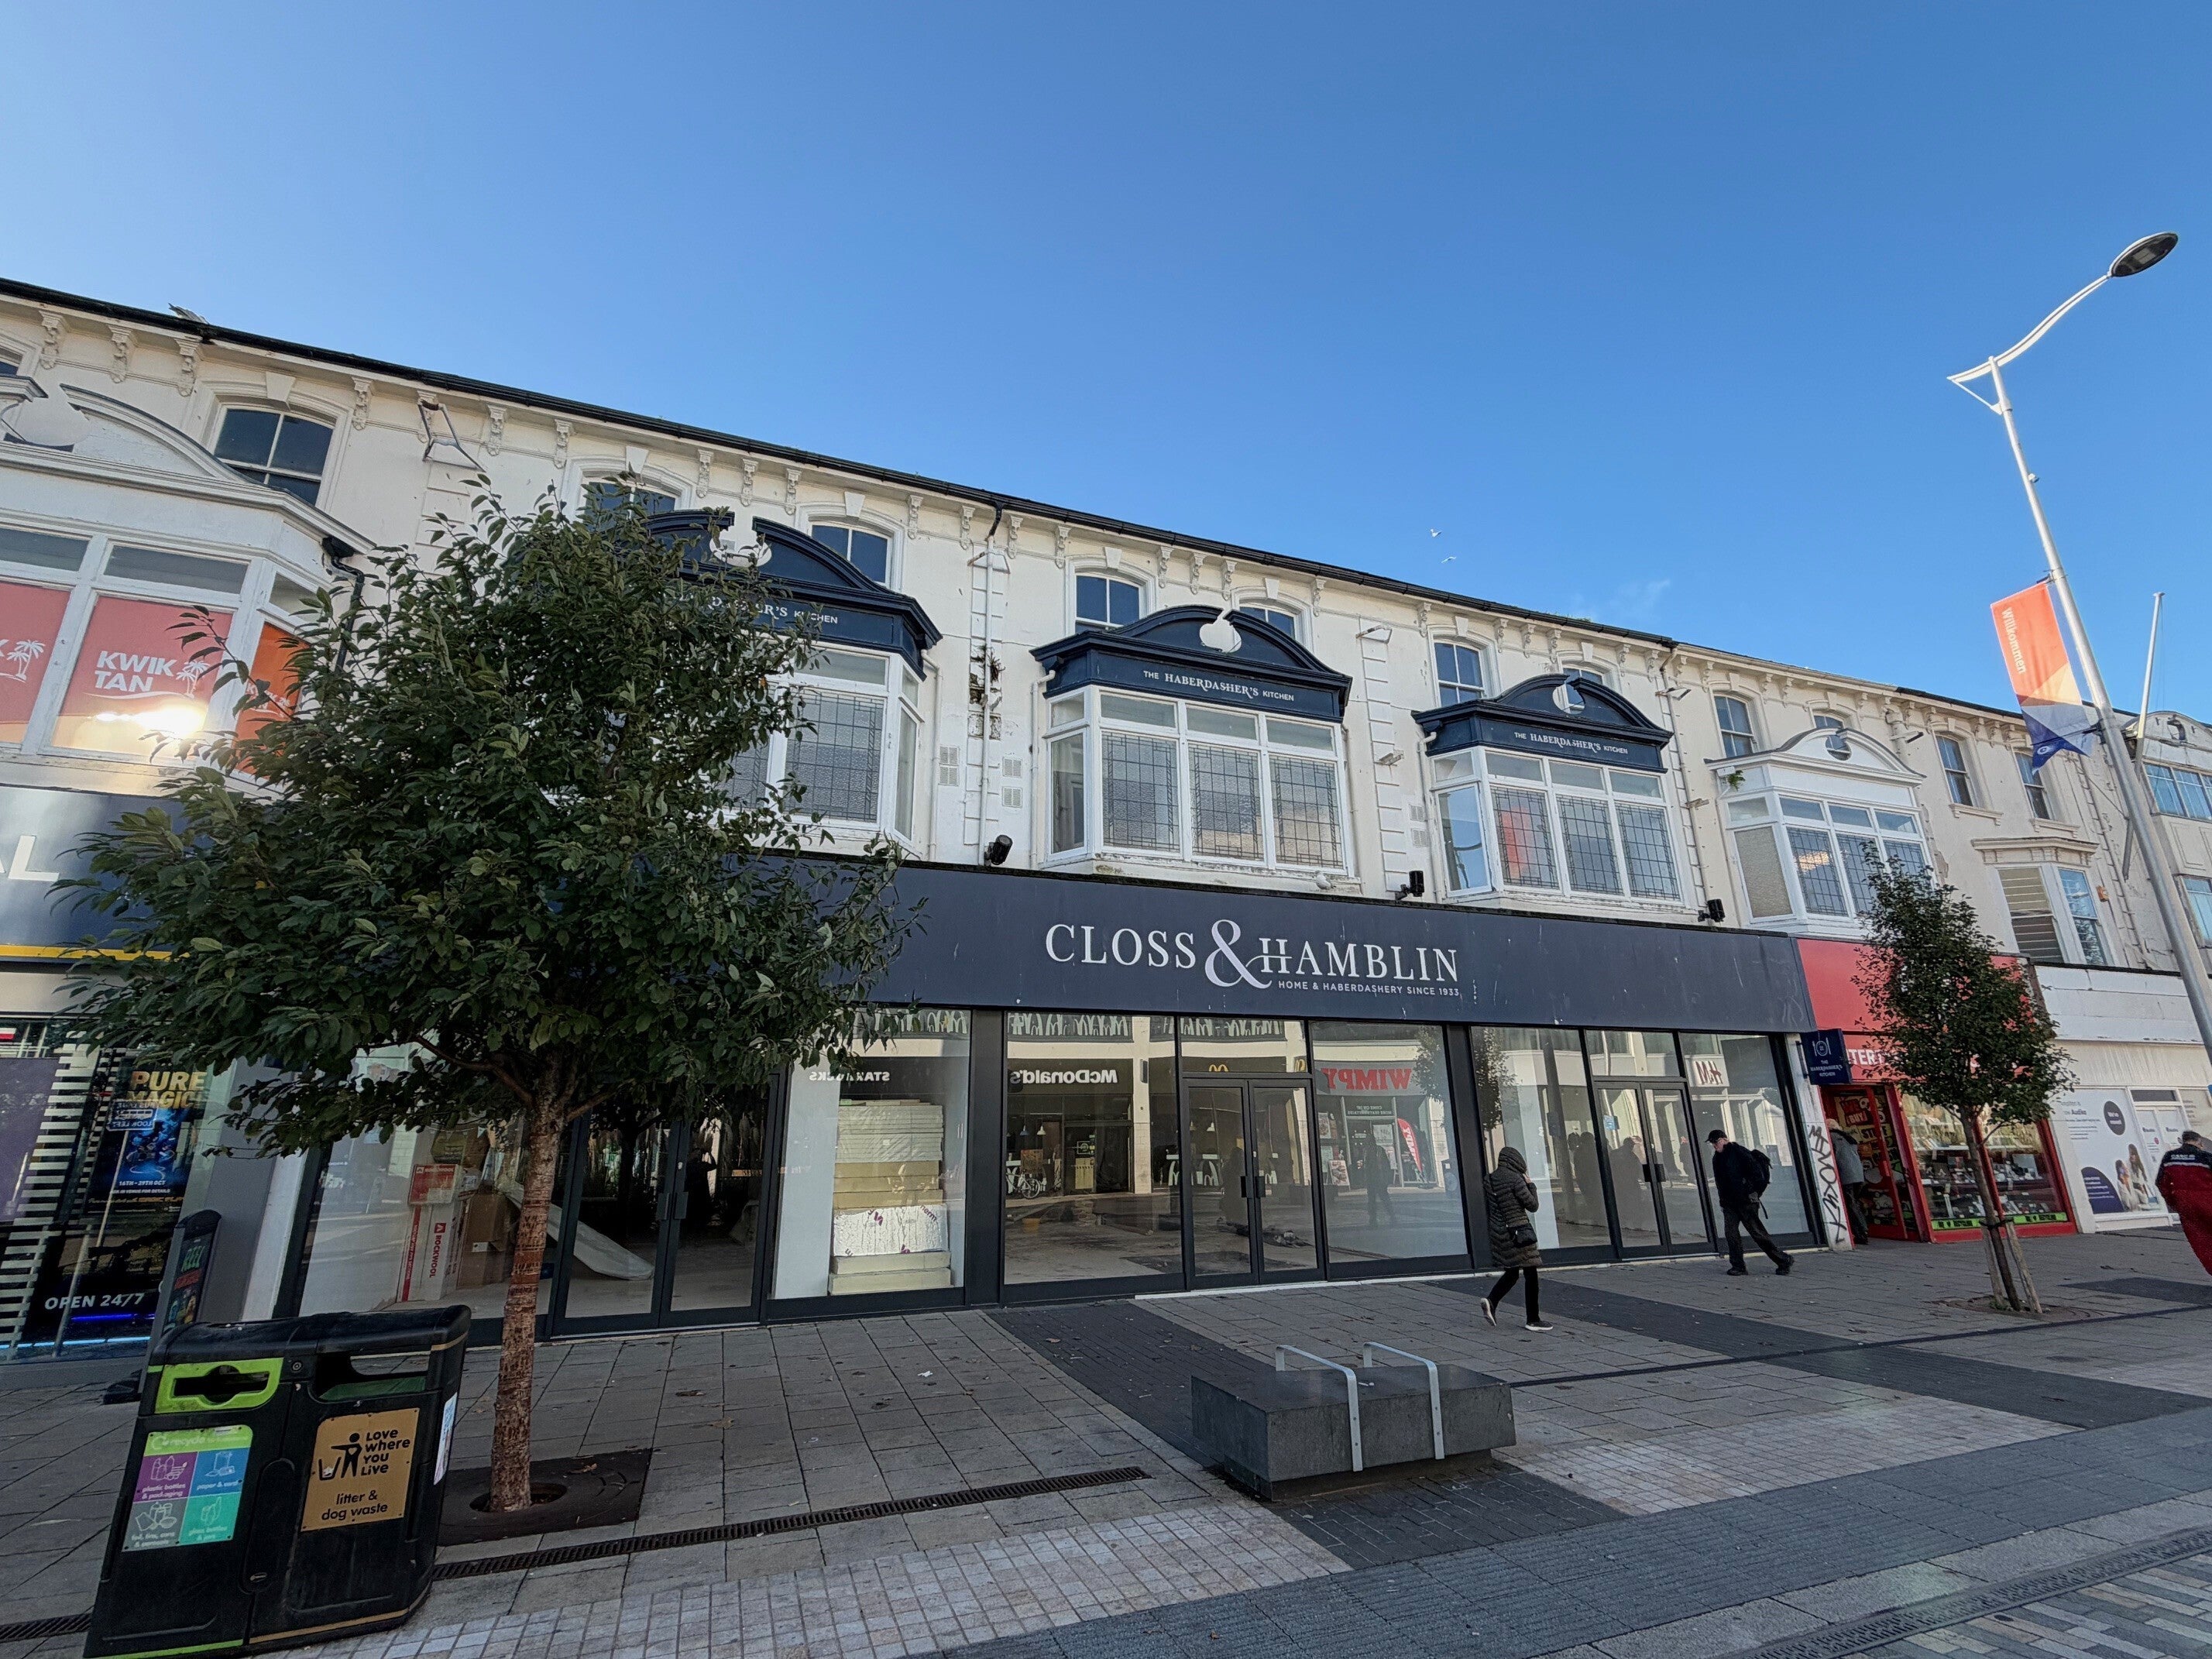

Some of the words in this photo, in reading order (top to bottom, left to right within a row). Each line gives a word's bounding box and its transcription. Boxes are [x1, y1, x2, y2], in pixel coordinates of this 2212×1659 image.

[794, 610, 838, 624] KCHEN
[2001, 606, 2026, 675] Willkommen
[97, 651, 177, 677] KWIK
[94, 670, 153, 692] TAN
[1143, 671, 1159, 680] THE
[1165, 673, 1259, 699] HABERDASHER'S
[1262, 690, 1294, 702] KITCHEN
[1530, 733, 1601, 753] HABERDASHER'S
[1603, 745, 1628, 754] KITCHEN
[0, 834, 60, 882] L
[1046, 924, 1196, 969] CLOSS
[1204, 919, 1273, 988] &
[1258, 937, 1458, 982] HAMBLIN
[1279, 981, 1308, 990] HOME
[1313, 982, 1319, 991] &
[1323, 983, 1403, 994] HABERDASHERY
[1407, 987, 1435, 995] SINCE
[1439, 988, 1460, 996] 1933
[129, 1071, 208, 1091] PURE
[429, 1235, 442, 1278] ROCKWOOL
[44, 1295, 95, 1310] OPEN
[100, 1293, 145, 1307] 24/7
[366, 1429, 398, 1441] Love
[366, 1438, 410, 1452] where
[363, 1453, 389, 1464] you
[361, 1464, 389, 1476] Live
[336, 1493, 365, 1505] litter
[368, 1489, 377, 1500] &
[321, 1509, 347, 1520] dog
[350, 1503, 388, 1516] waste
